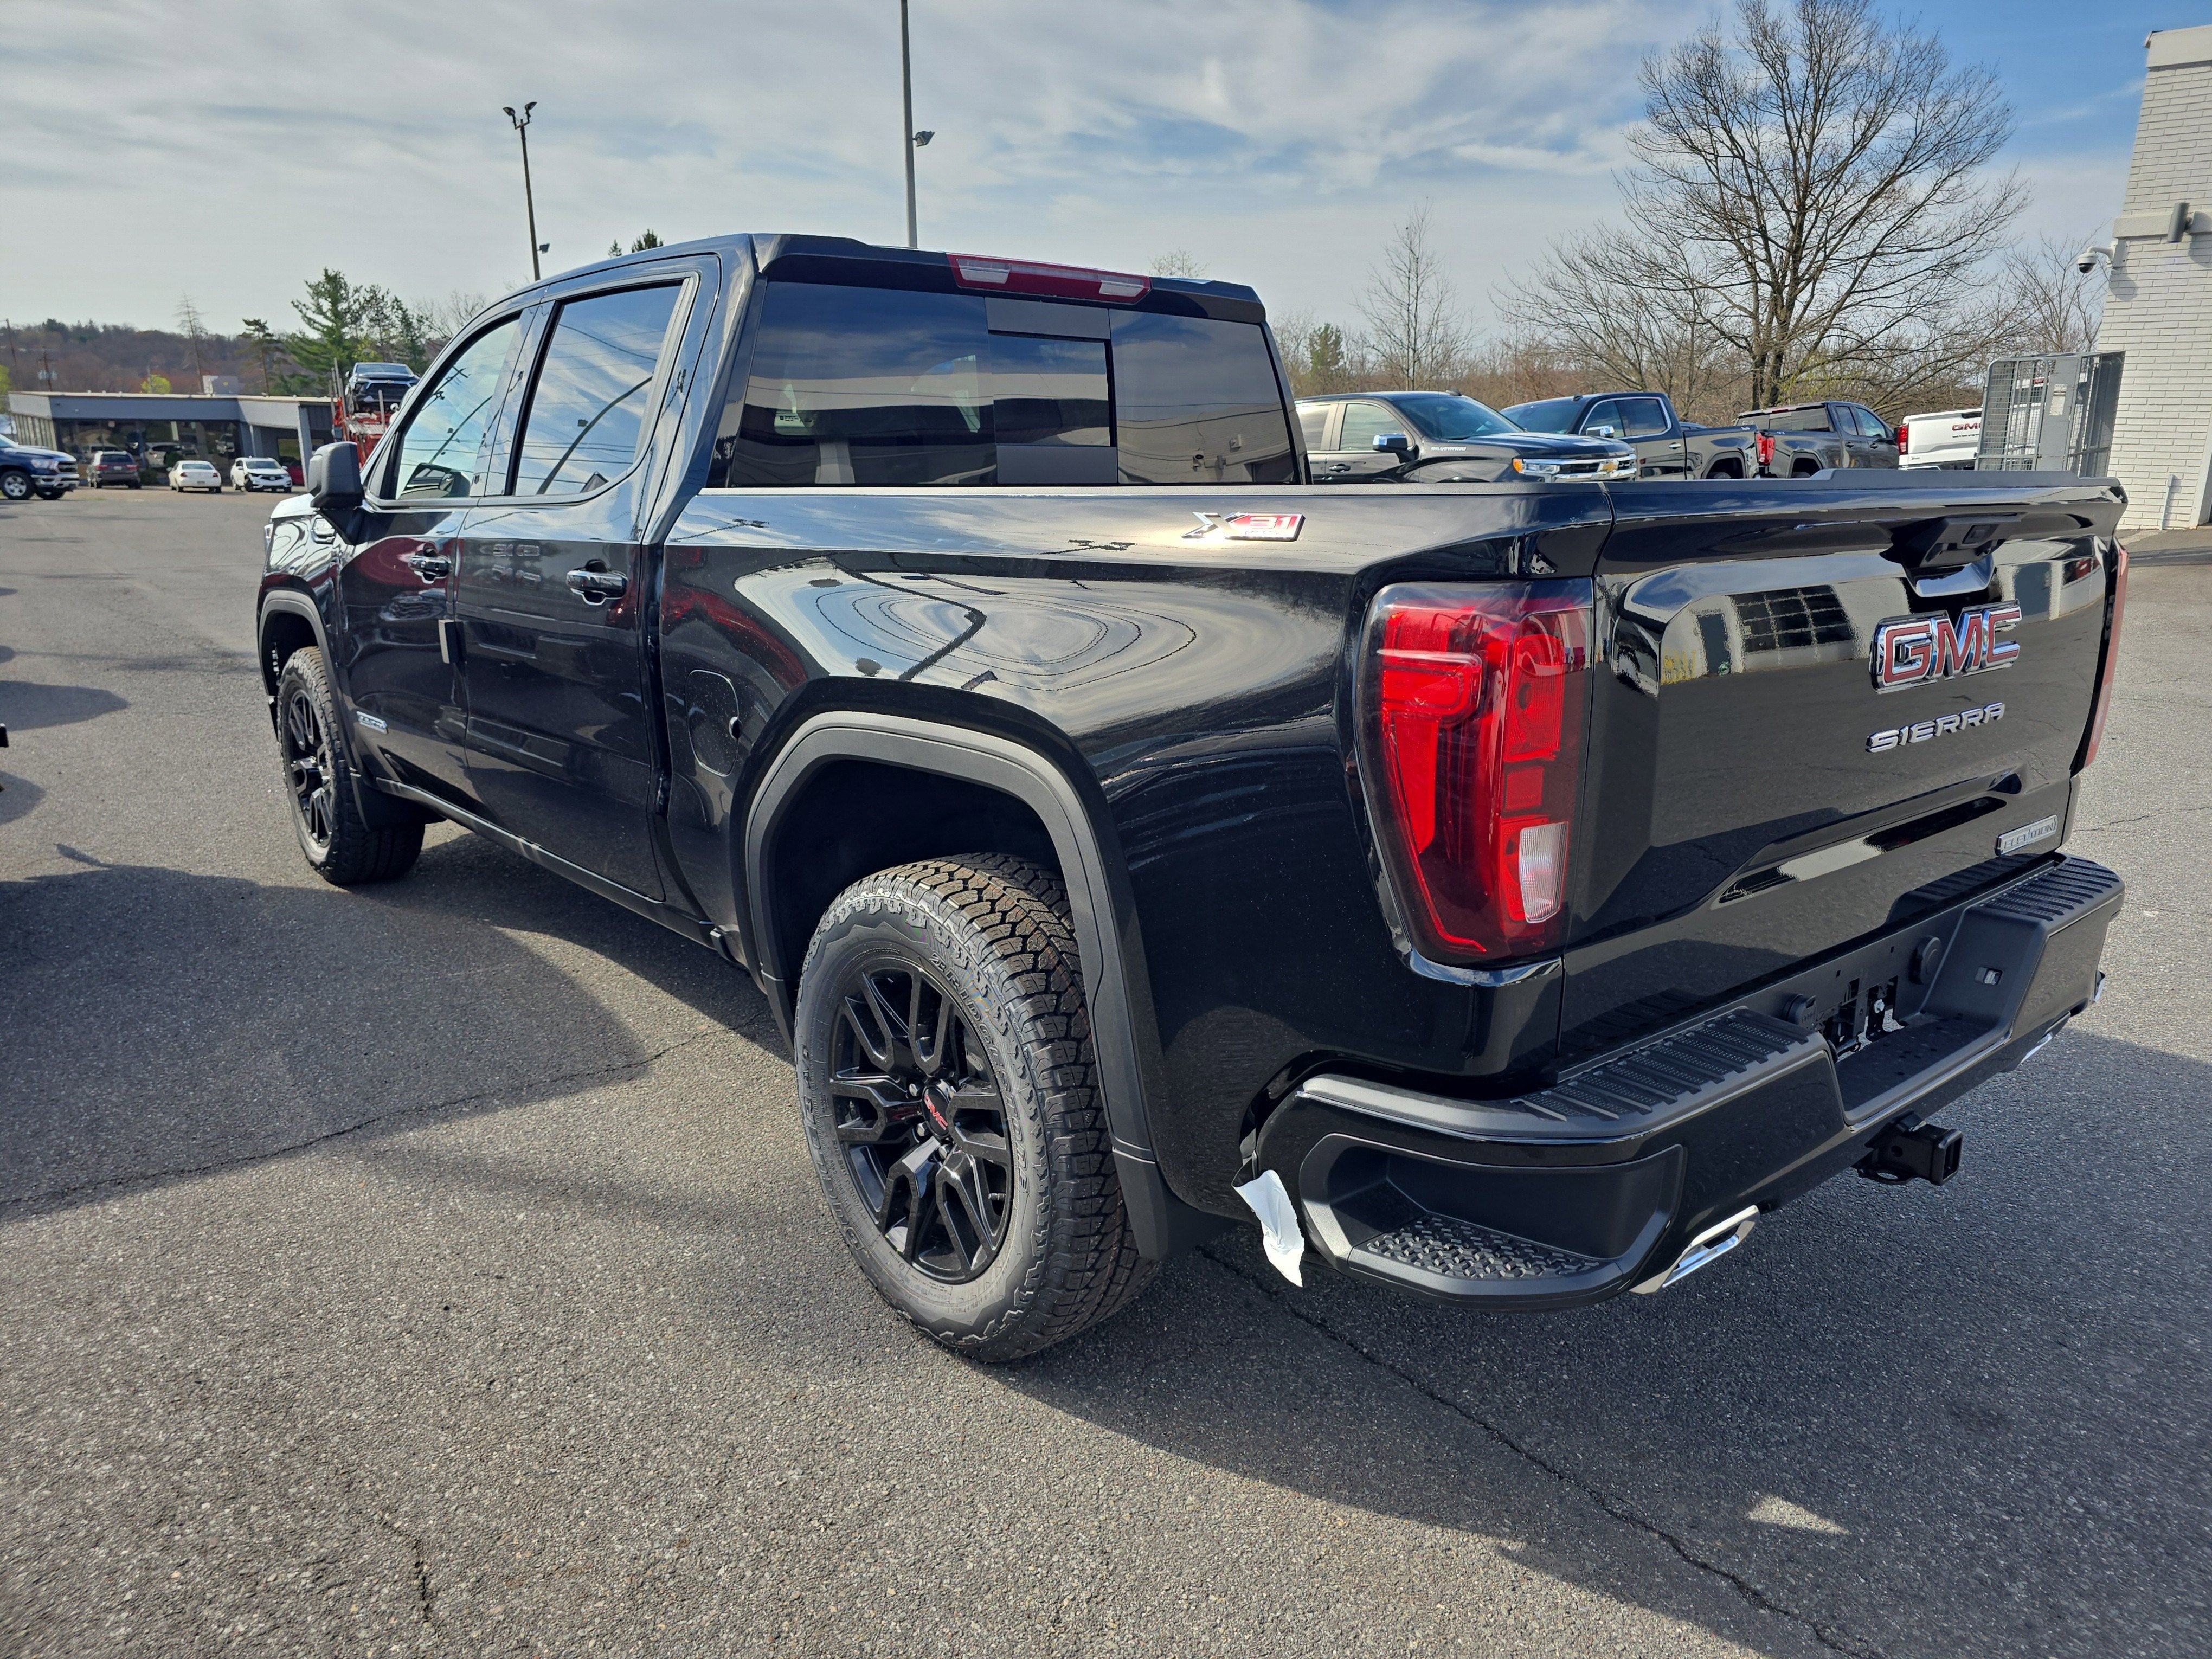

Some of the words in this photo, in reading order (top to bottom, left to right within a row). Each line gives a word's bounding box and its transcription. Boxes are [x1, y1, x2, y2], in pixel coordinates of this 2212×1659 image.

[1952, 422, 1981, 432] GM
[1870, 605, 2022, 692] GMC
[1866, 702, 2005, 753] SIERRA
[929, 951, 1029, 1192] BRIDGESTONE
[924, 1089, 948, 1130] GMC
